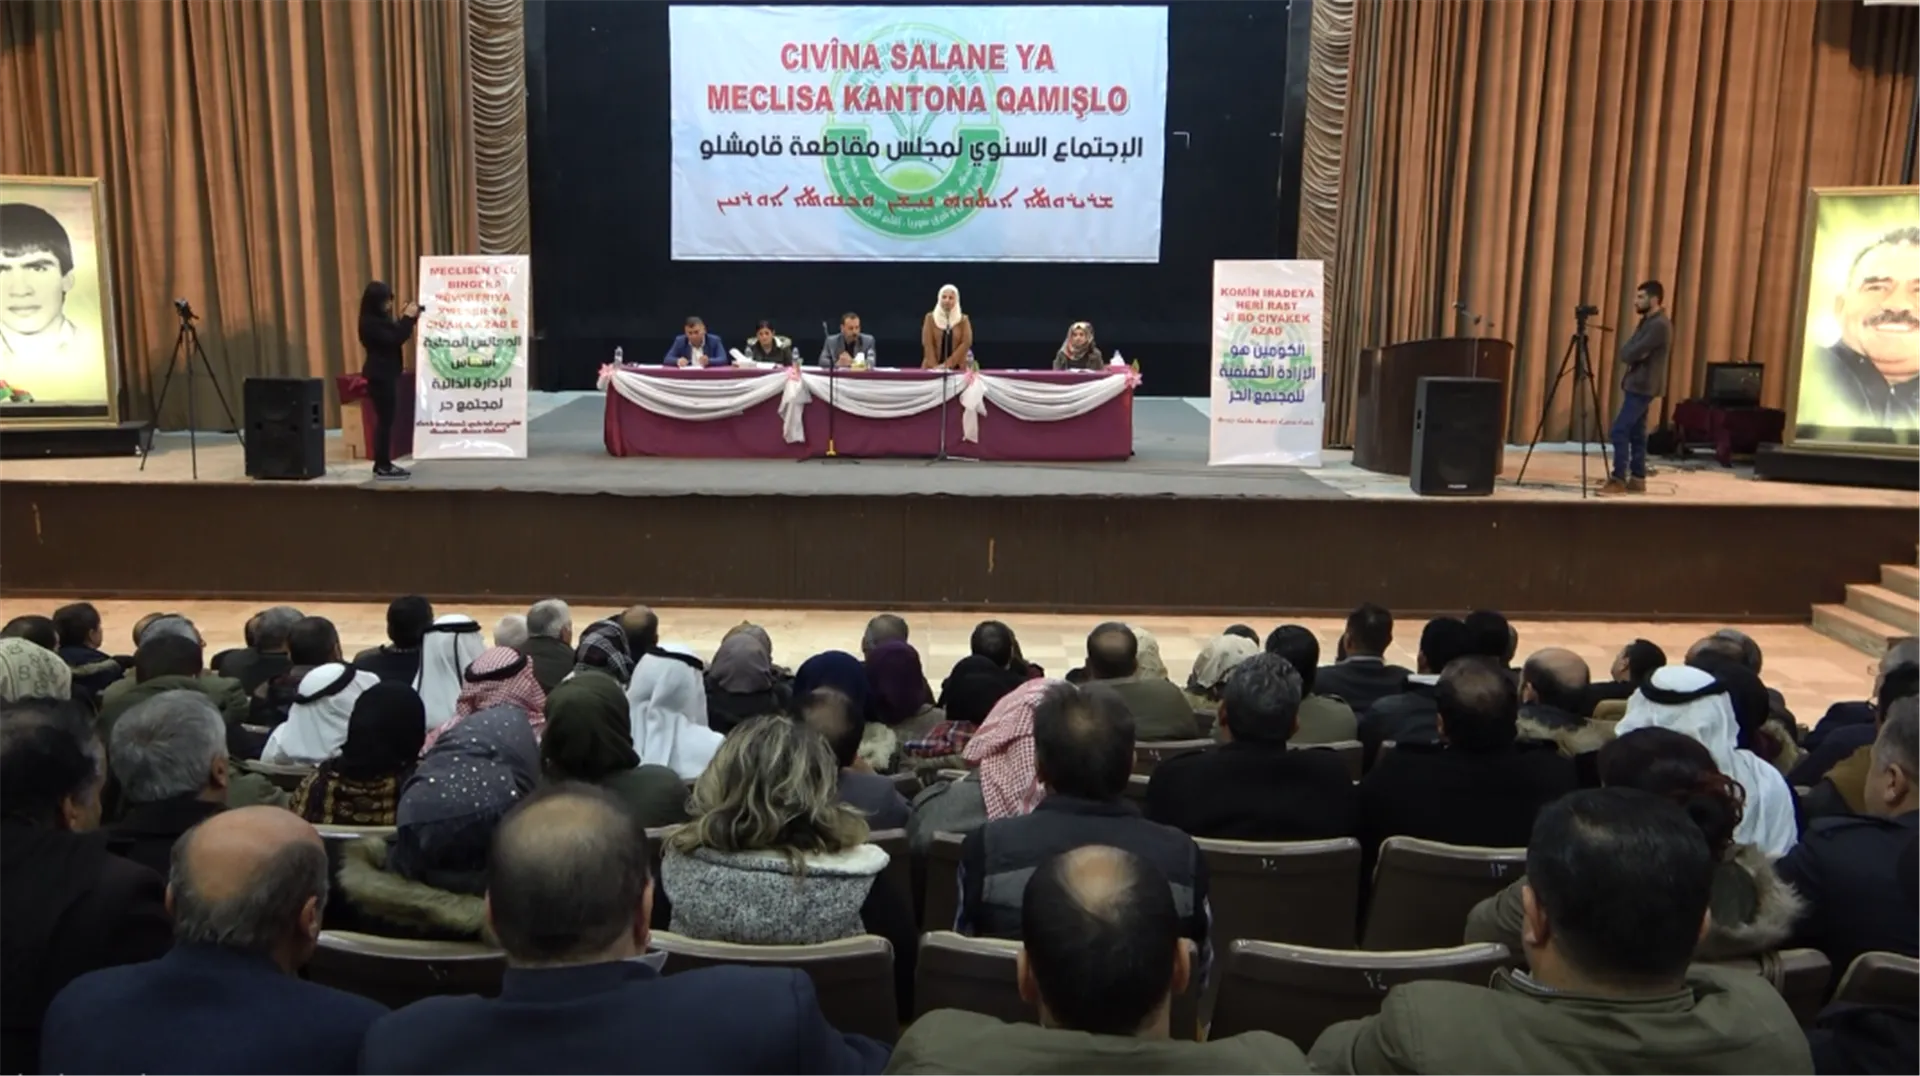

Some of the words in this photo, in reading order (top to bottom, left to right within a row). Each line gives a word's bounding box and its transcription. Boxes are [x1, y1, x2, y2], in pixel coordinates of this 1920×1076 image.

[781, 37, 882, 71] CIVÎNA
[890, 43, 1006, 71] SALANE
[1016, 44, 1056, 71] YA
[707, 85, 834, 112] MECLISA
[844, 85, 987, 113] KANTONA
[996, 86, 1129, 119] QAMIŞLO
[699, 131, 783, 160] قامشلو
[789, 135, 880, 157] مقاطعة
[887, 136, 963, 161] لمجلس
[969, 136, 1047, 167] السنوي
[1053, 136, 1143, 163] الإجتماع
[1251, 326, 1283, 336] AZAD
